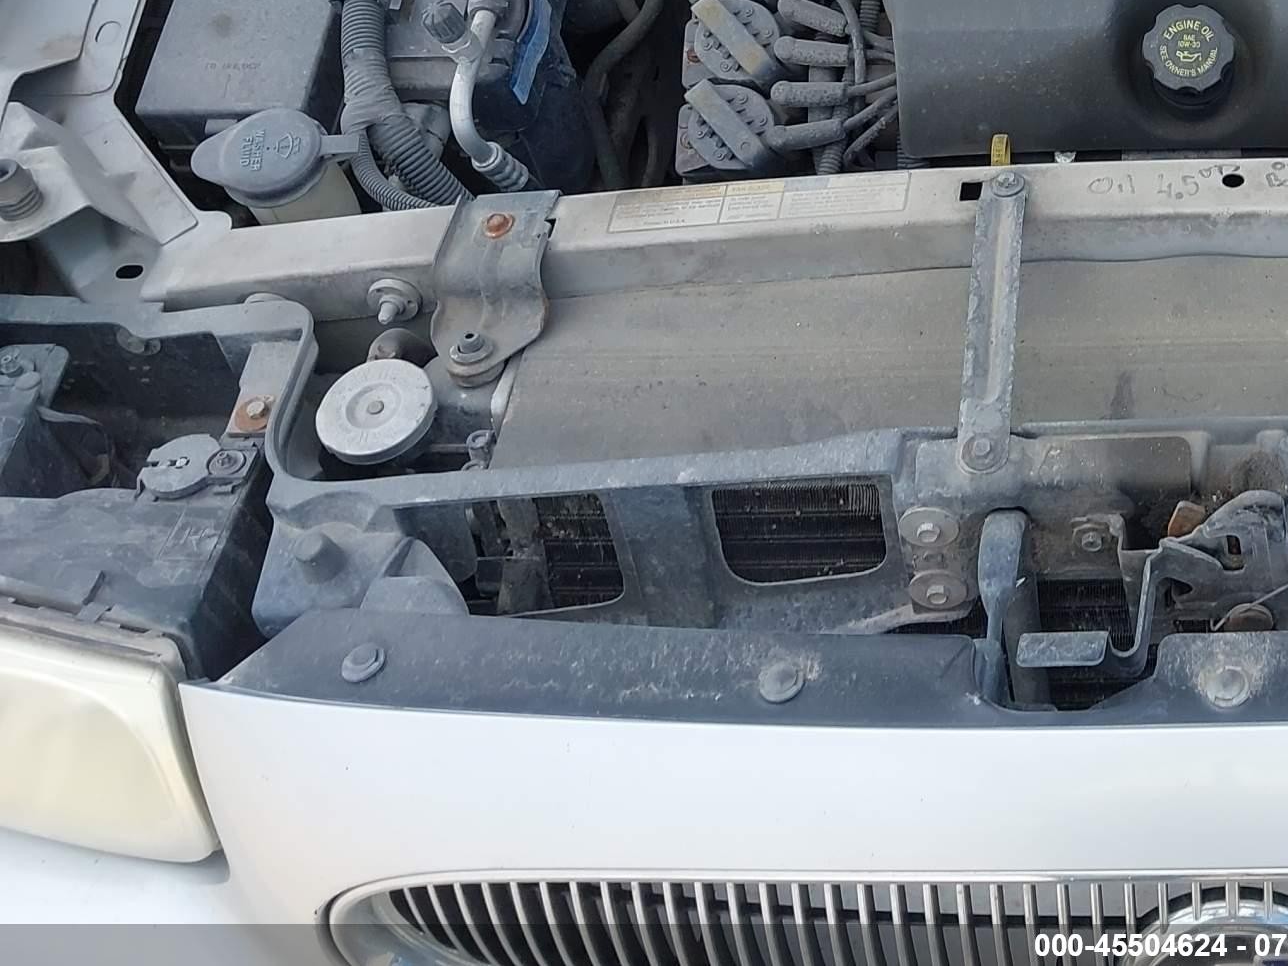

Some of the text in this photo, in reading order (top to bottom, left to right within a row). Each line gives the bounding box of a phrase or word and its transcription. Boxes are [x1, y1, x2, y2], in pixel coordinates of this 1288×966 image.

[1163, 20, 1215, 42] ENGINE OIL
[1159, 44, 1218, 77] SEE OWNER'S MANUAL
[239, 136, 253, 168] FLUID
[250, 129, 265, 172] WASHER
[1086, 173, 1136, 195] Oil
